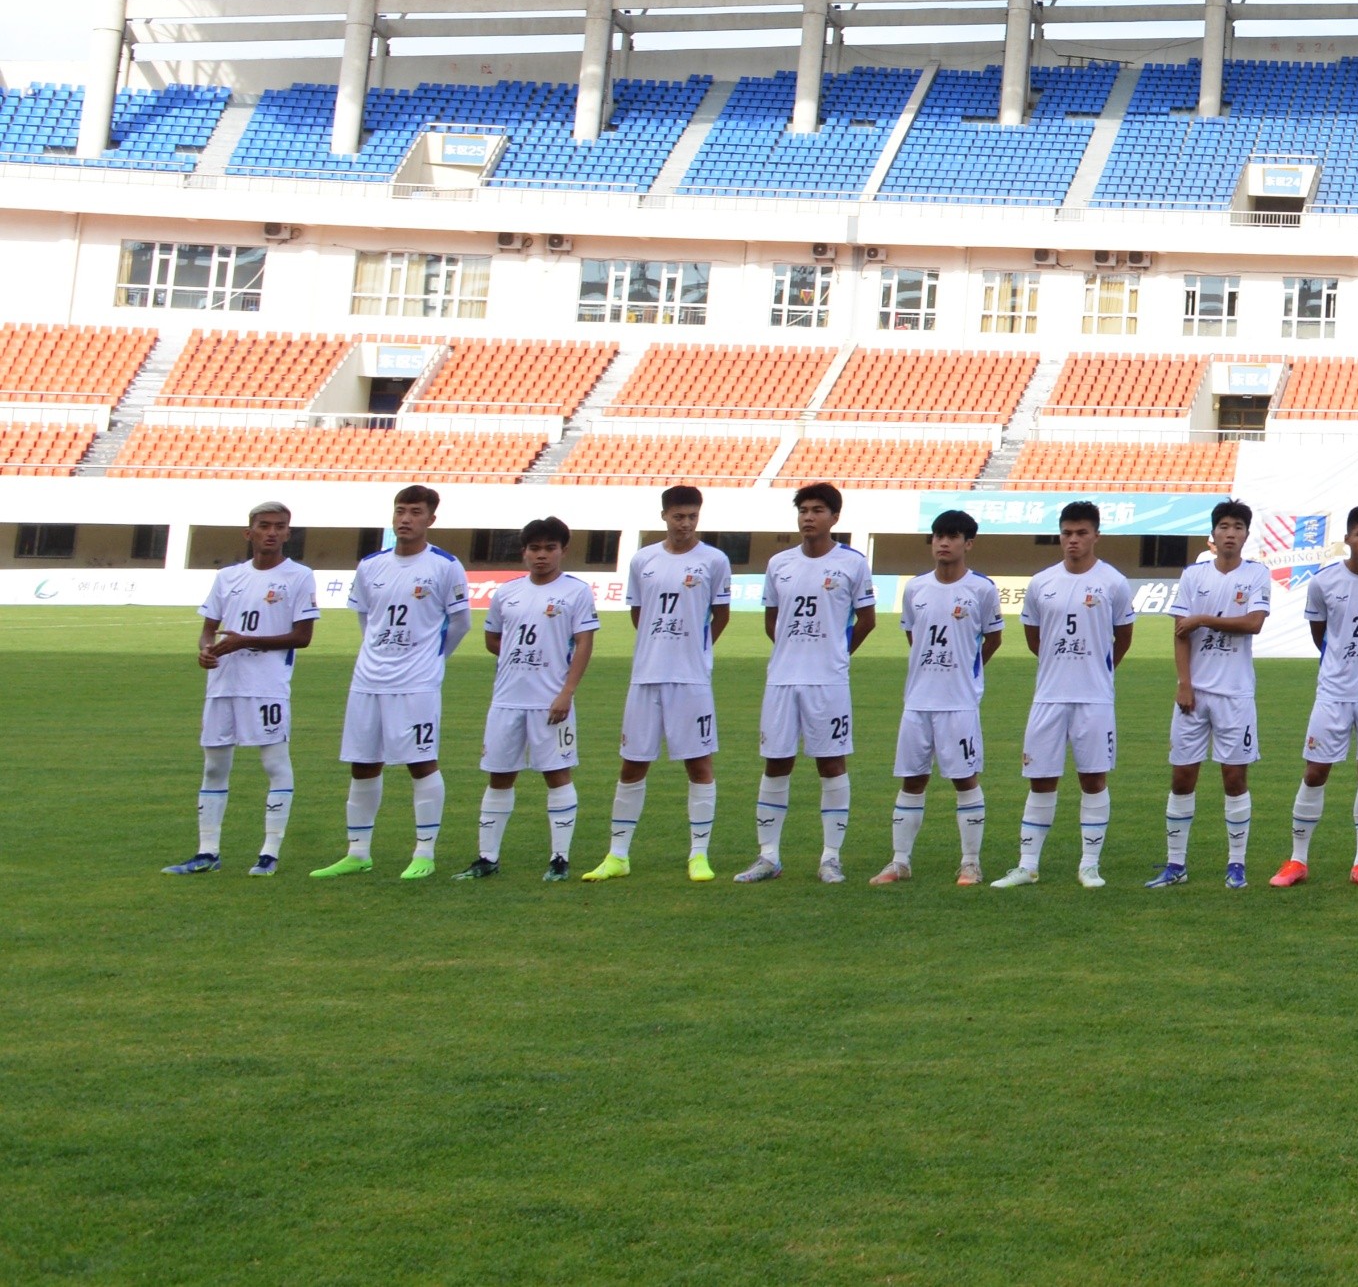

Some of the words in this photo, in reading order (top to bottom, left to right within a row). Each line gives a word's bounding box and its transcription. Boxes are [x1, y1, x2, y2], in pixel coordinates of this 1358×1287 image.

[444, 143, 486, 157] 东区25
[1264, 176, 1301, 187] 东区24
[659, 592, 680, 614] 17
[793, 595, 818, 617] 25
[241, 610, 260, 631] 10
[387, 604, 408, 626] 12
[1066, 613, 1077, 635] 5
[518, 623, 537, 646] 16
[929, 624, 948, 647] 14
[260, 703, 282, 727] 10
[697, 713, 713, 738] 17
[412, 722, 434, 746] 12
[558, 726, 575, 748] 16
[830, 714, 849, 740] 25
[1243, 725, 1252, 748] 6
